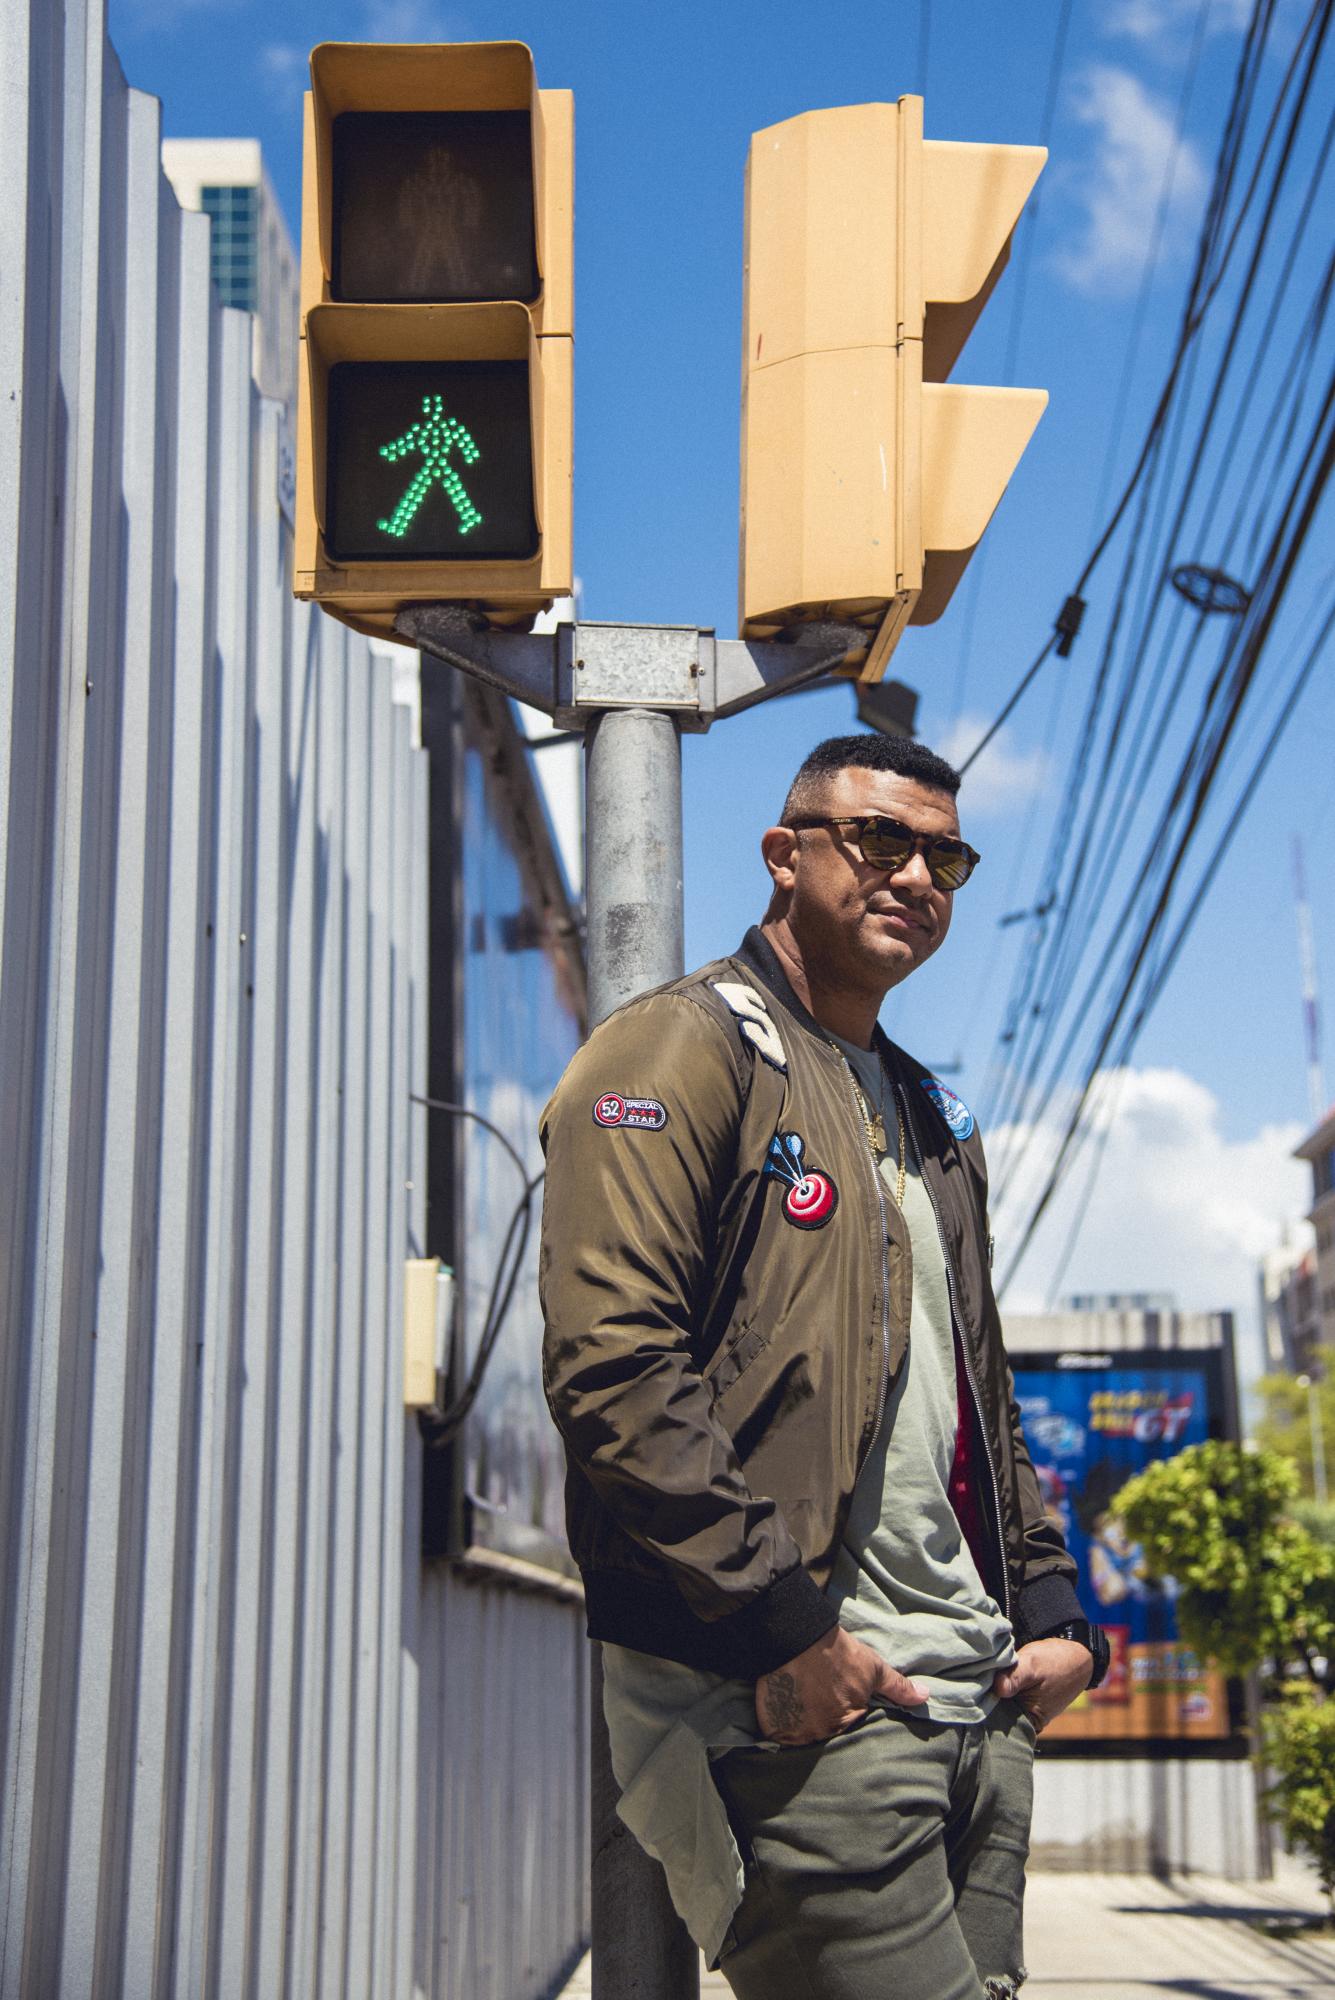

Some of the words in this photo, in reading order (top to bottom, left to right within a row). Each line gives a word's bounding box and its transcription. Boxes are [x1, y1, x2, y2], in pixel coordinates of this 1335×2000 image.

[602, 1100, 620, 1117] 52
[627, 1102, 659, 1110] SPECIAL
[627, 1115, 656, 1124] STAR
